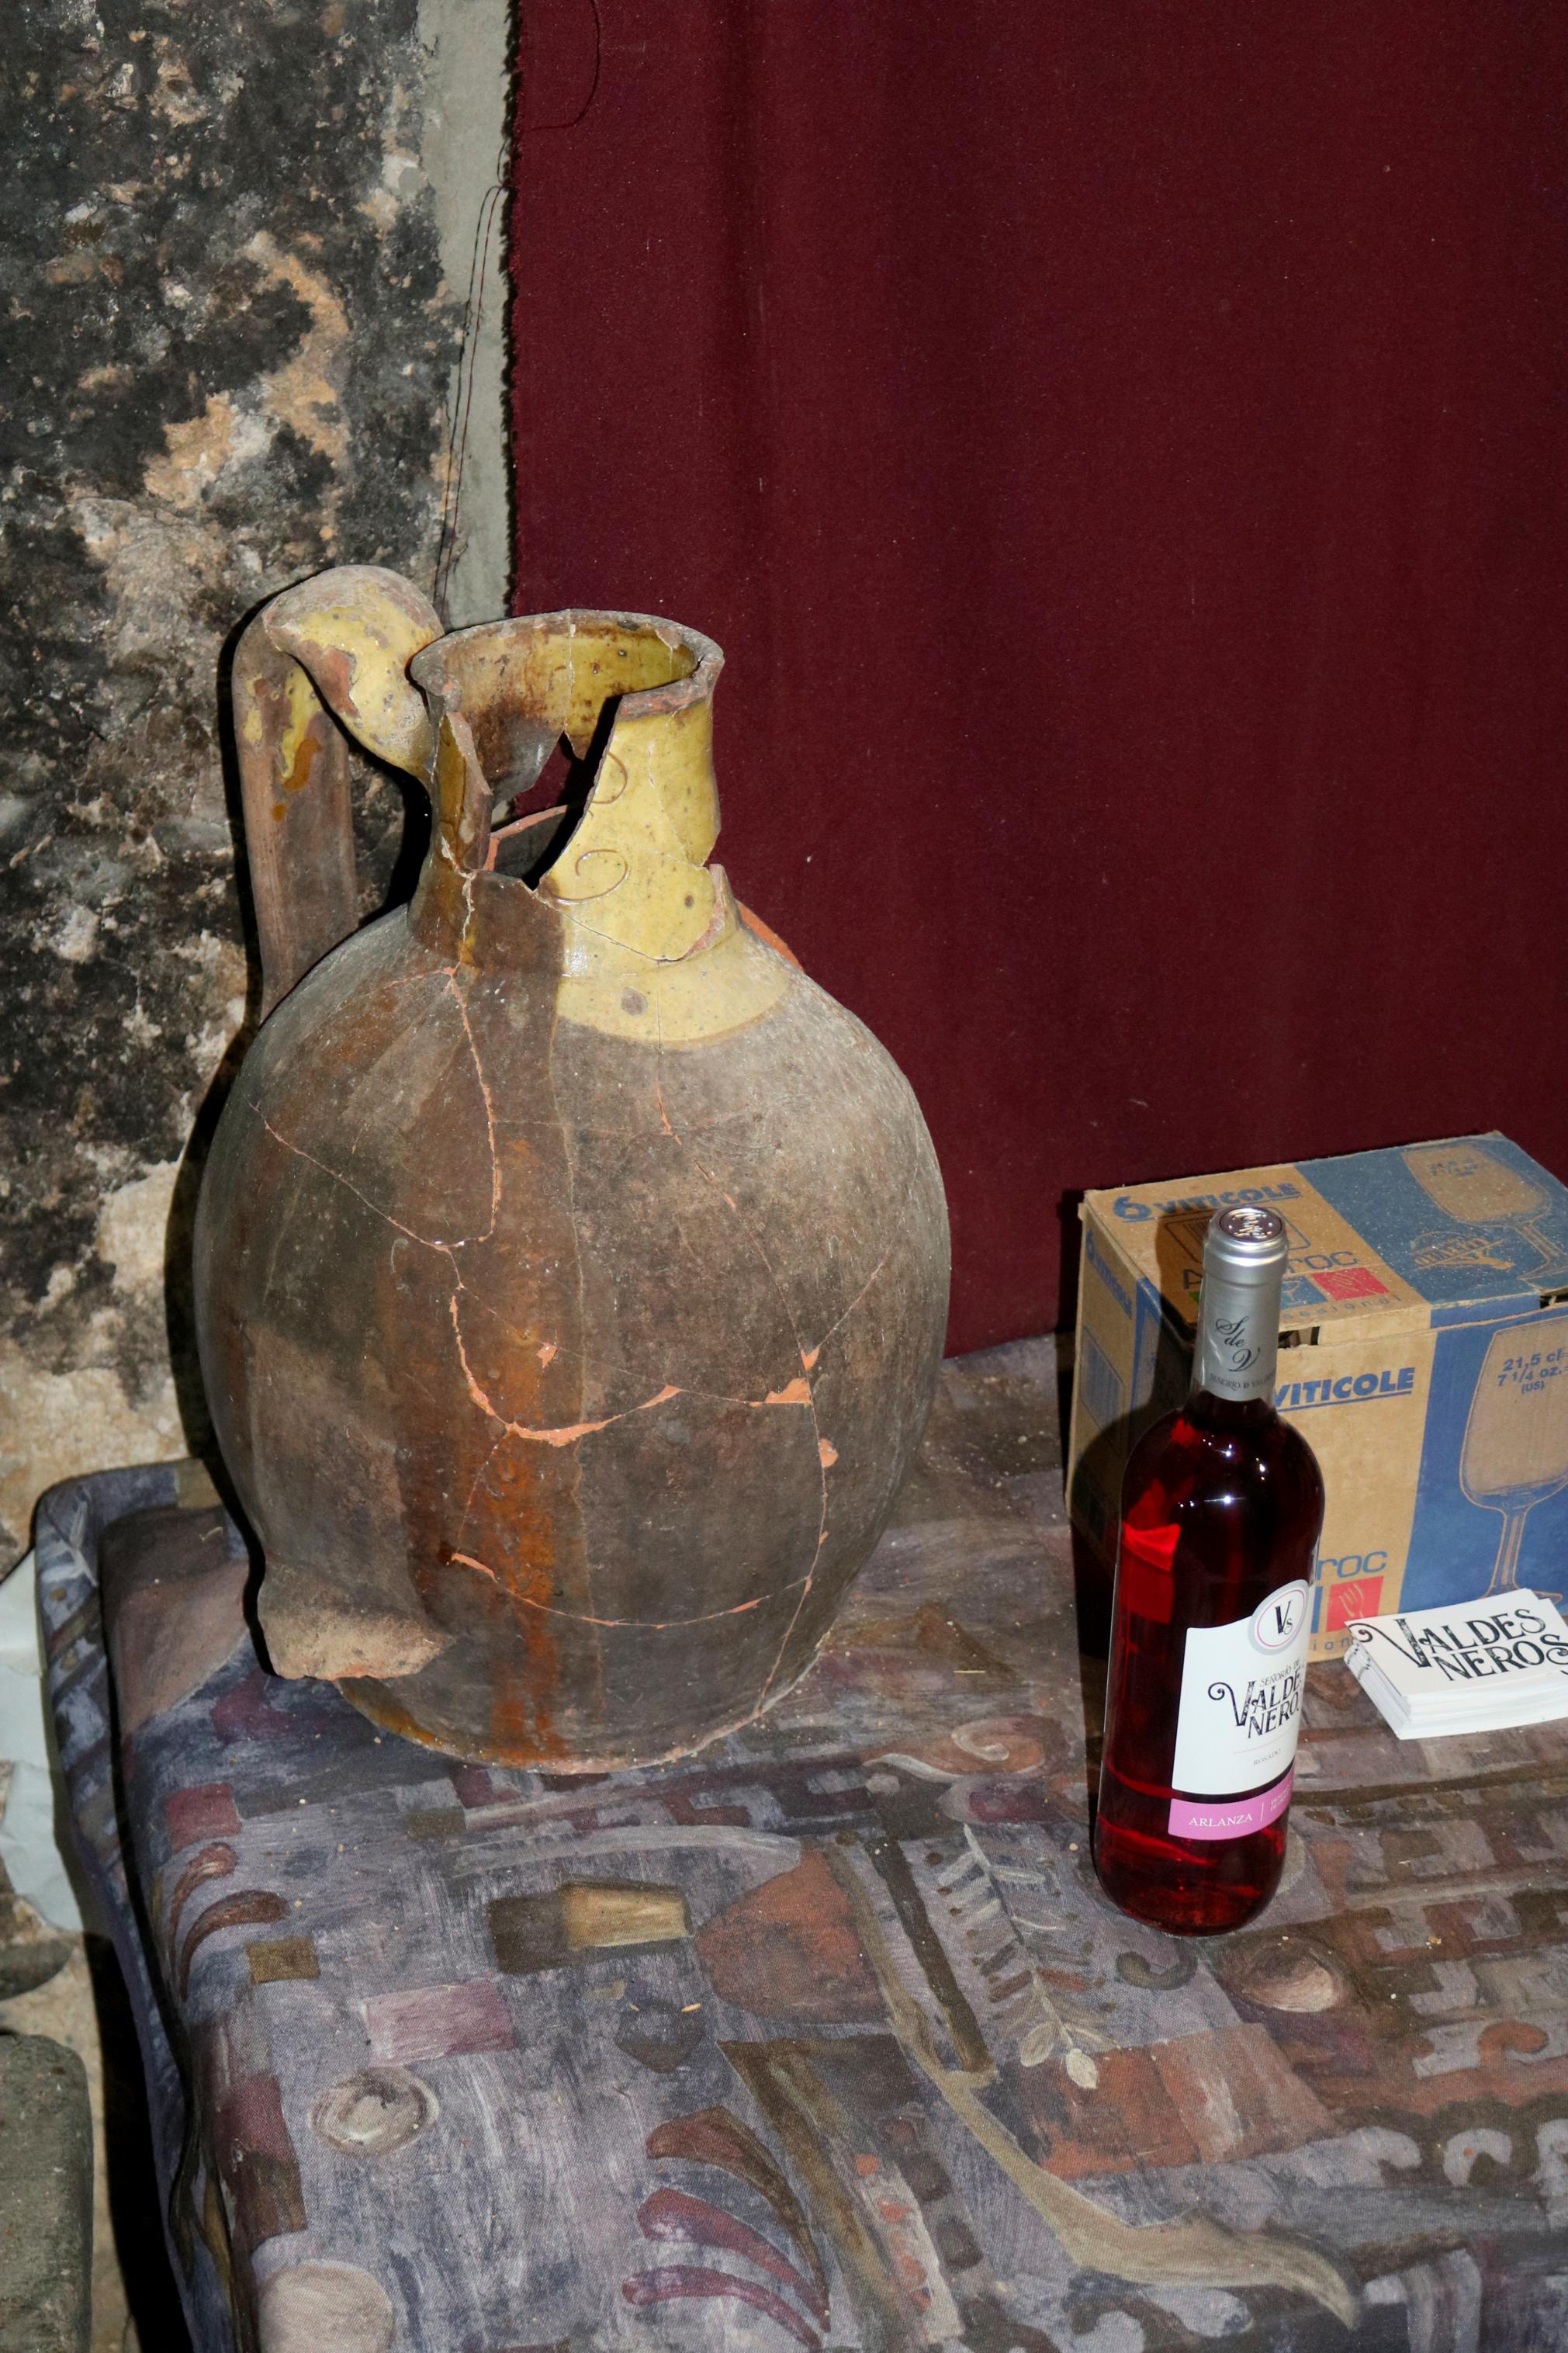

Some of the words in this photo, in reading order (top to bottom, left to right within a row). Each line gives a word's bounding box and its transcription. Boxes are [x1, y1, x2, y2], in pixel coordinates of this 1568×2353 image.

[1113, 1196, 1151, 1221] 6
[1153, 1183, 1301, 1215] VITICOLE
[1224, 1329, 1245, 1348] de
[1274, 1367, 1415, 1408] VITICOLE
[1497, 1374, 1507, 1387] 7
[1512, 1364, 1534, 1383] 1/4
[1539, 1367, 1563, 1378] oz.
[1521, 1381, 1545, 1395] (US)
[1348, 1609, 1546, 1668] VALDES
[1429, 1634, 1568, 1682] NEROS
[1189, 1813, 1253, 1827] ARLANZA
